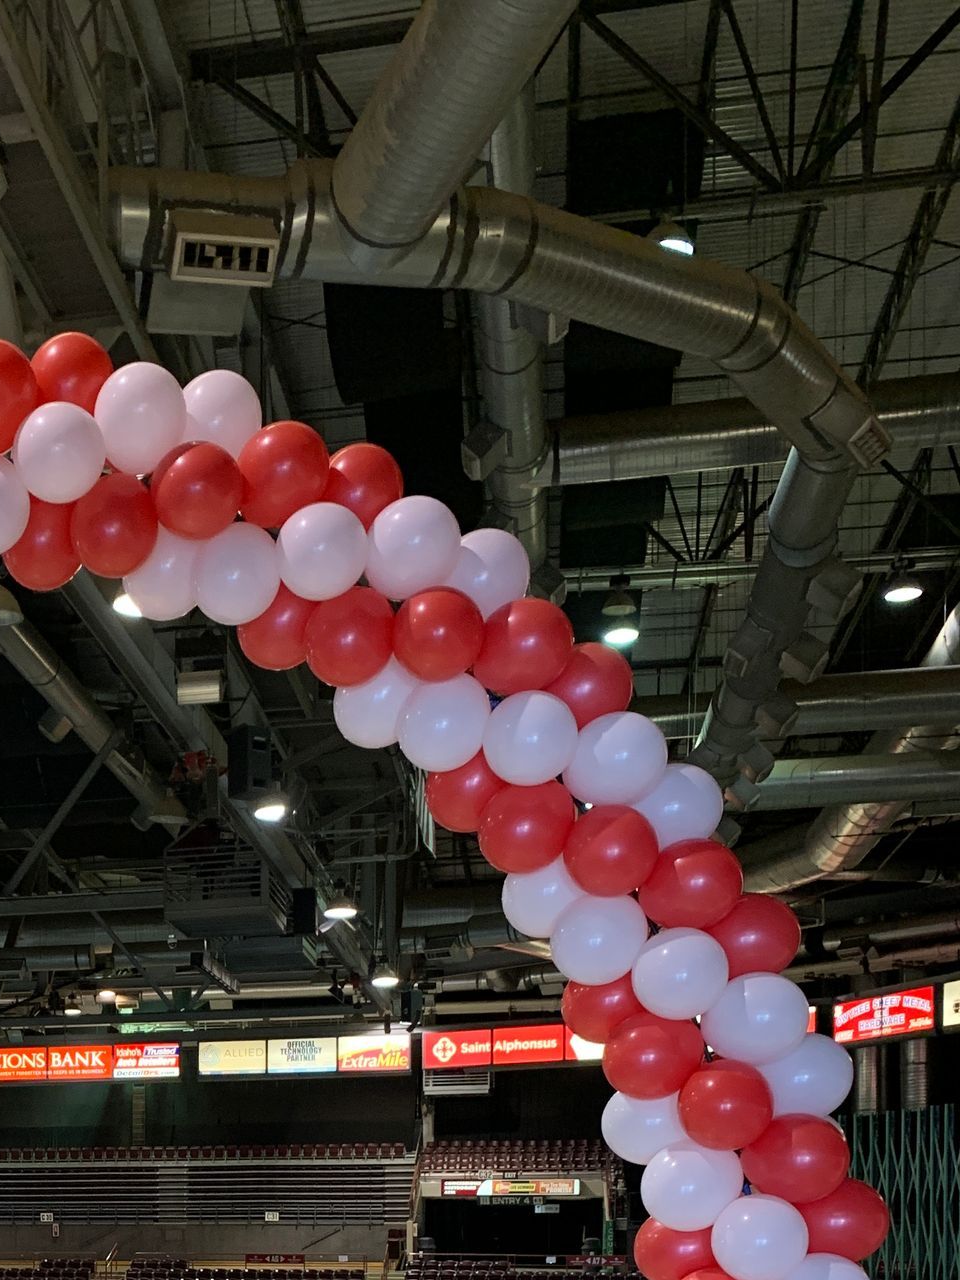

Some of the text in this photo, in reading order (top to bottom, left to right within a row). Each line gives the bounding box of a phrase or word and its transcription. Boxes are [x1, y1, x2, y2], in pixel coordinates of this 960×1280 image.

[872, 996, 901, 1009] SHEET
[903, 996, 931, 1012] METAL
[858, 1014, 905, 1031] HARDWARE
[280, 1047, 322, 1055] TECHNOLOGY
[461, 1039, 557, 1053] Saint Alphonsus
[116, 1047, 176, 1057] Idaho's Trusted
[224, 1047, 264, 1058] ALLIED
[50, 1051, 105, 1067] BANK
[116, 1058, 137, 1067] Auto
[286, 1054, 316, 1062] PARTNER
[341, 1049, 409, 1068] ExtraMile
[492, 1197, 530, 1205] ENTRY 4
[592, 1257, 600, 1265] A7
